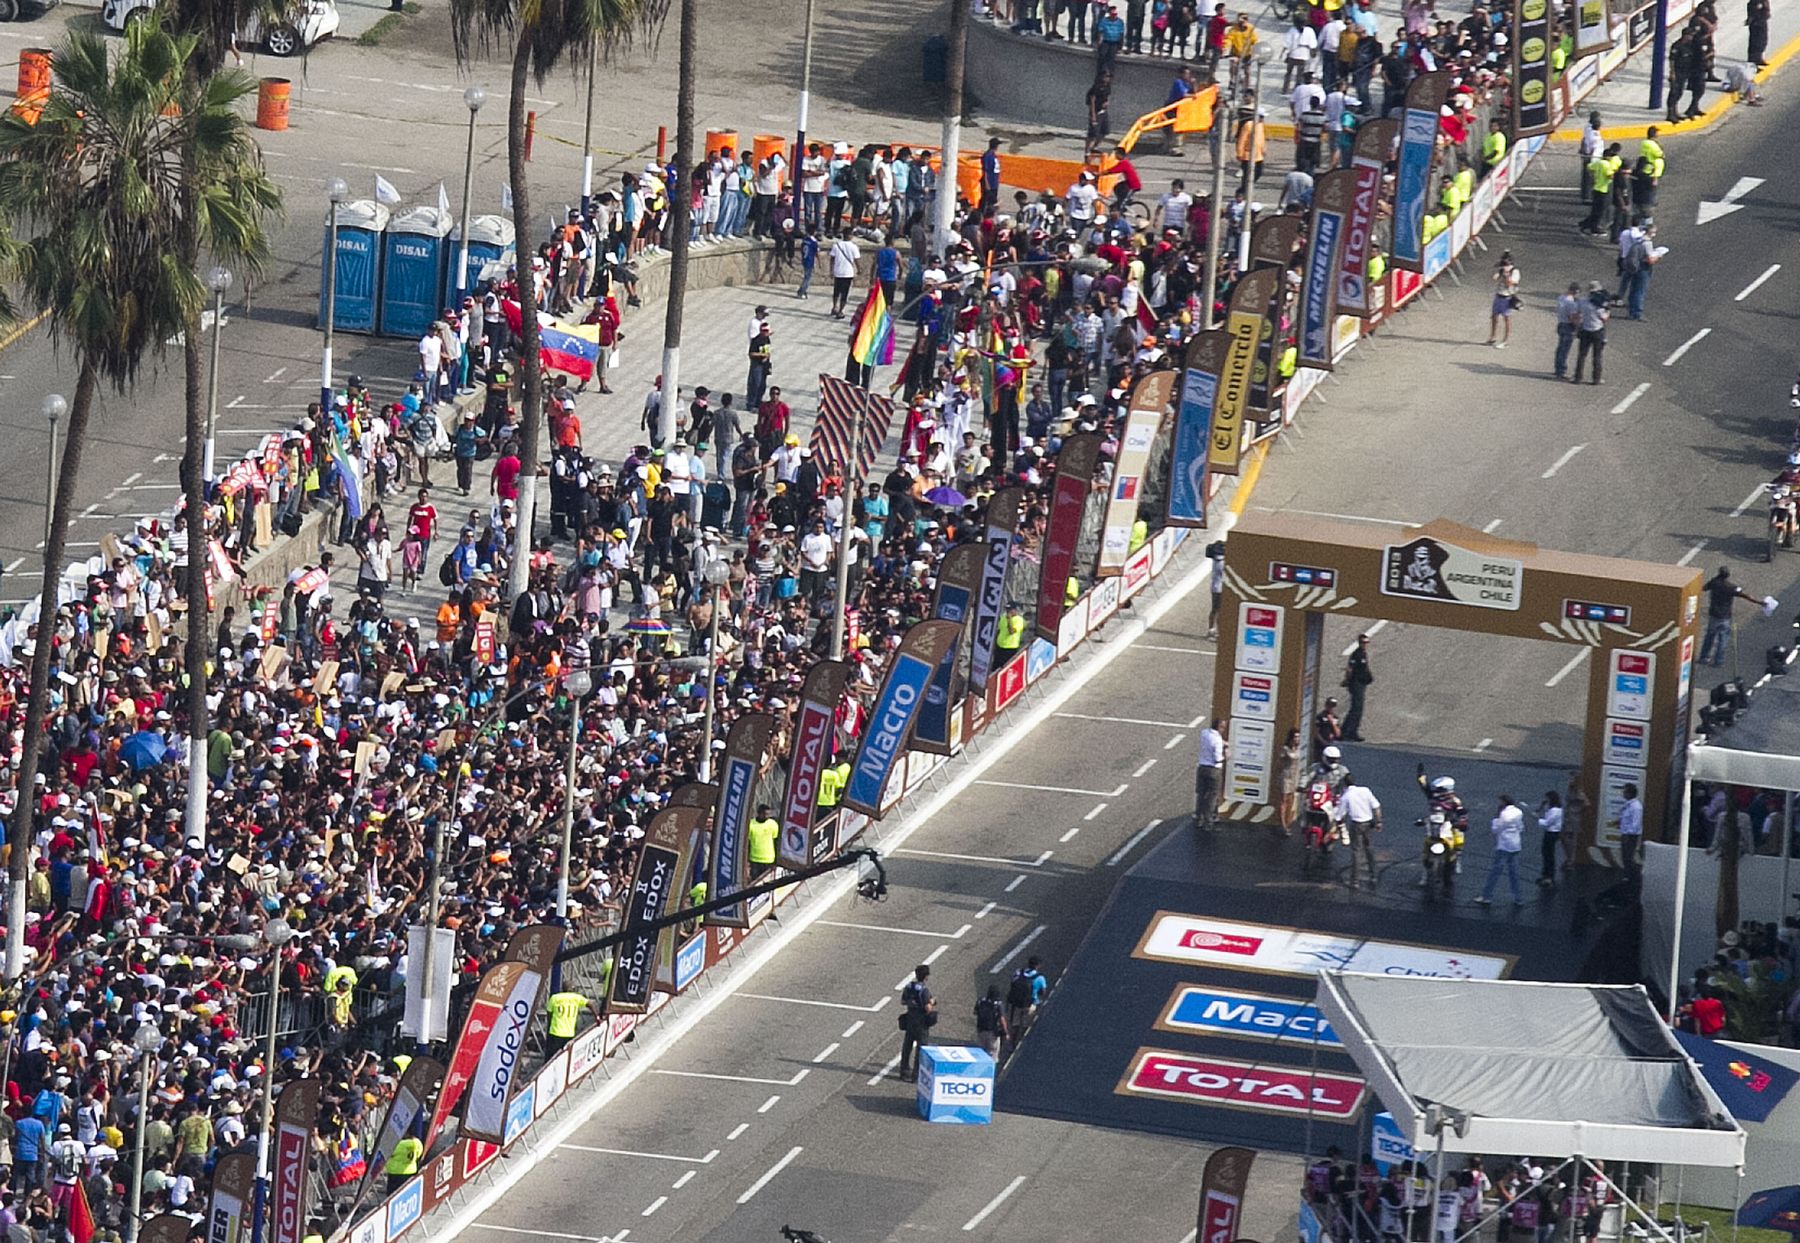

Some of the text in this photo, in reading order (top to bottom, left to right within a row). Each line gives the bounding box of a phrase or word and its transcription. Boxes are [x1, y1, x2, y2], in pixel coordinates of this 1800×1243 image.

[336, 240, 368, 252] DISAL
[1344, 170, 1376, 269] TOTAL
[396, 244, 429, 257] DISAL
[1308, 217, 1335, 323] MICHELIN
[1214, 324, 1252, 450] El Comercio
[1446, 573, 1513, 588] ARGENTINA
[1480, 590, 1513, 602] CHILE
[1482, 564, 1516, 576] PERU
[860, 684, 916, 781] Macro
[790, 718, 825, 822] TOTAL
[720, 766, 746, 880] MICHELIN
[643, 860, 667, 922] EDOX
[628, 936, 648, 995] EDOX
[1202, 1000, 1331, 1033] Macr
[491, 1000, 529, 1103] sodexo
[940, 1081, 986, 1096] TECHO
[1153, 1065, 1343, 1105] TOTAL
[278, 1141, 300, 1243] TOTAL
[212, 1208, 229, 1243] ER
